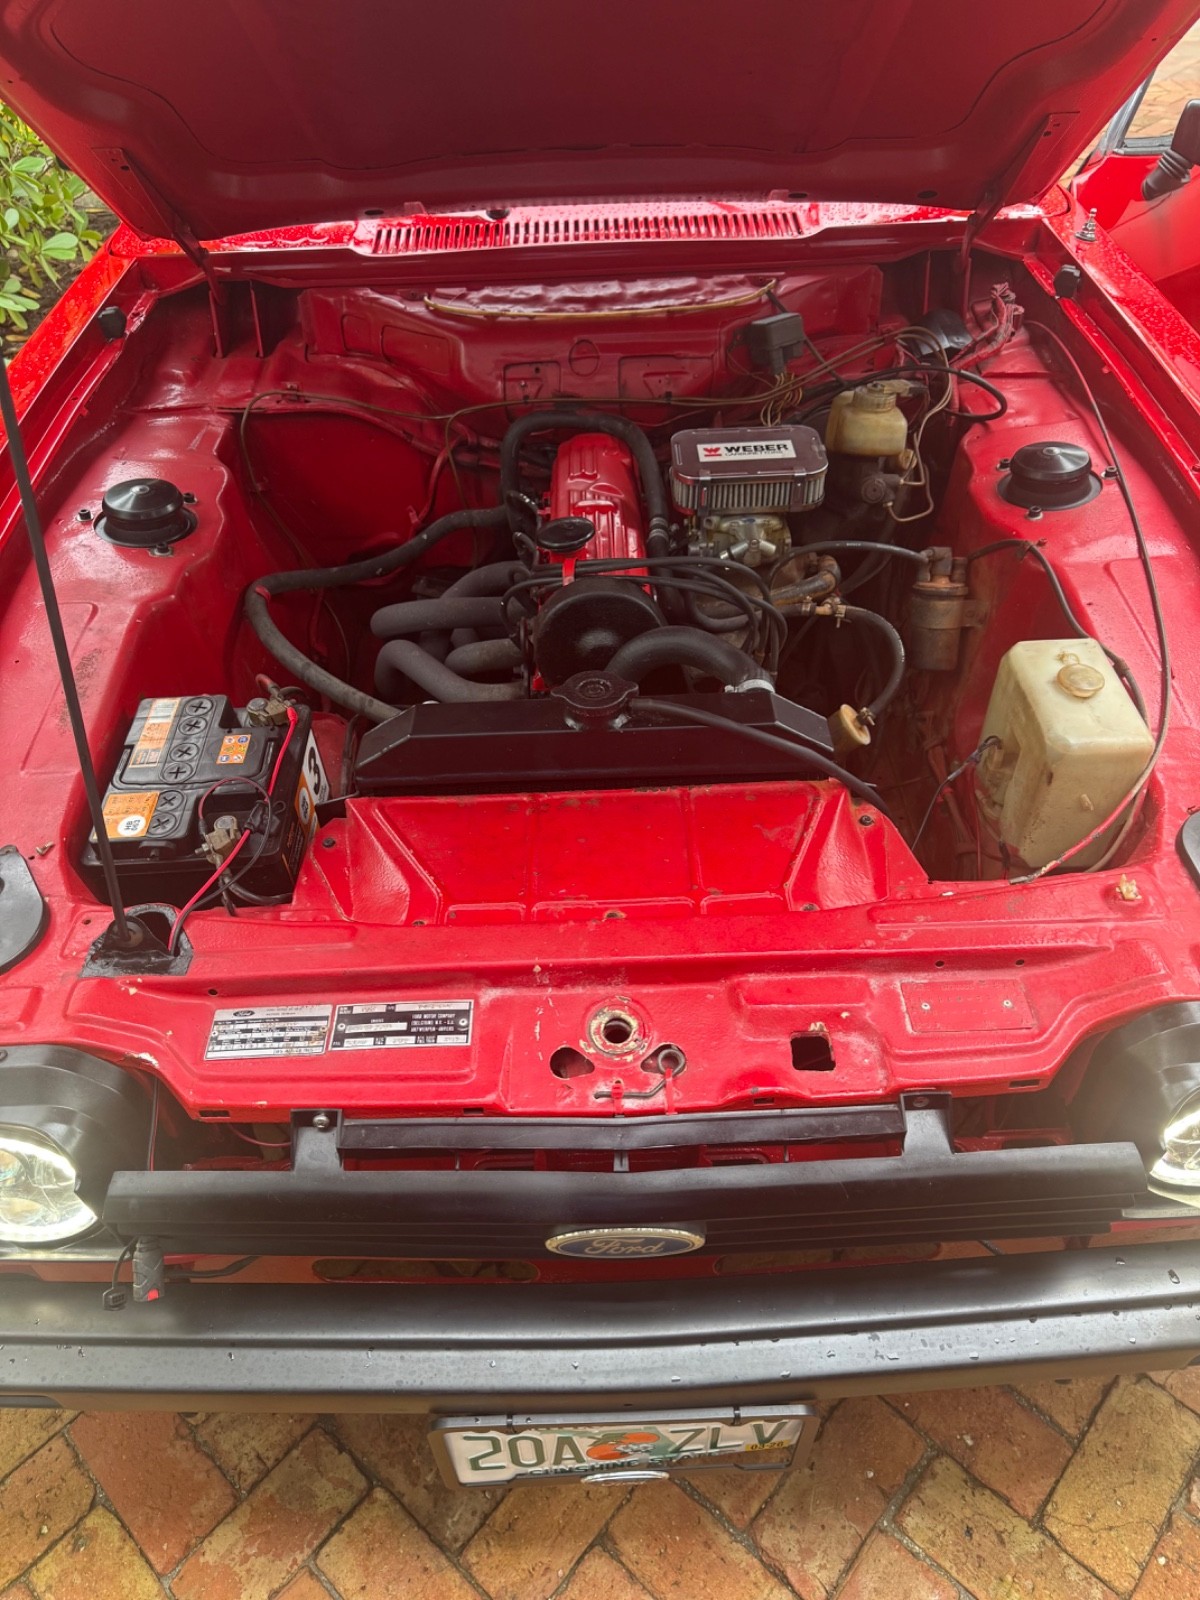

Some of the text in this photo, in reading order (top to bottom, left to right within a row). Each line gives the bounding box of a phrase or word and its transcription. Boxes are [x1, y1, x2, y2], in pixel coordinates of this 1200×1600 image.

[724, 444, 789, 453] WEBER
[308, 746, 322, 796] 3
[584, 1238, 666, 1255] Ford
[668, 1420, 790, 1453] ZLV
